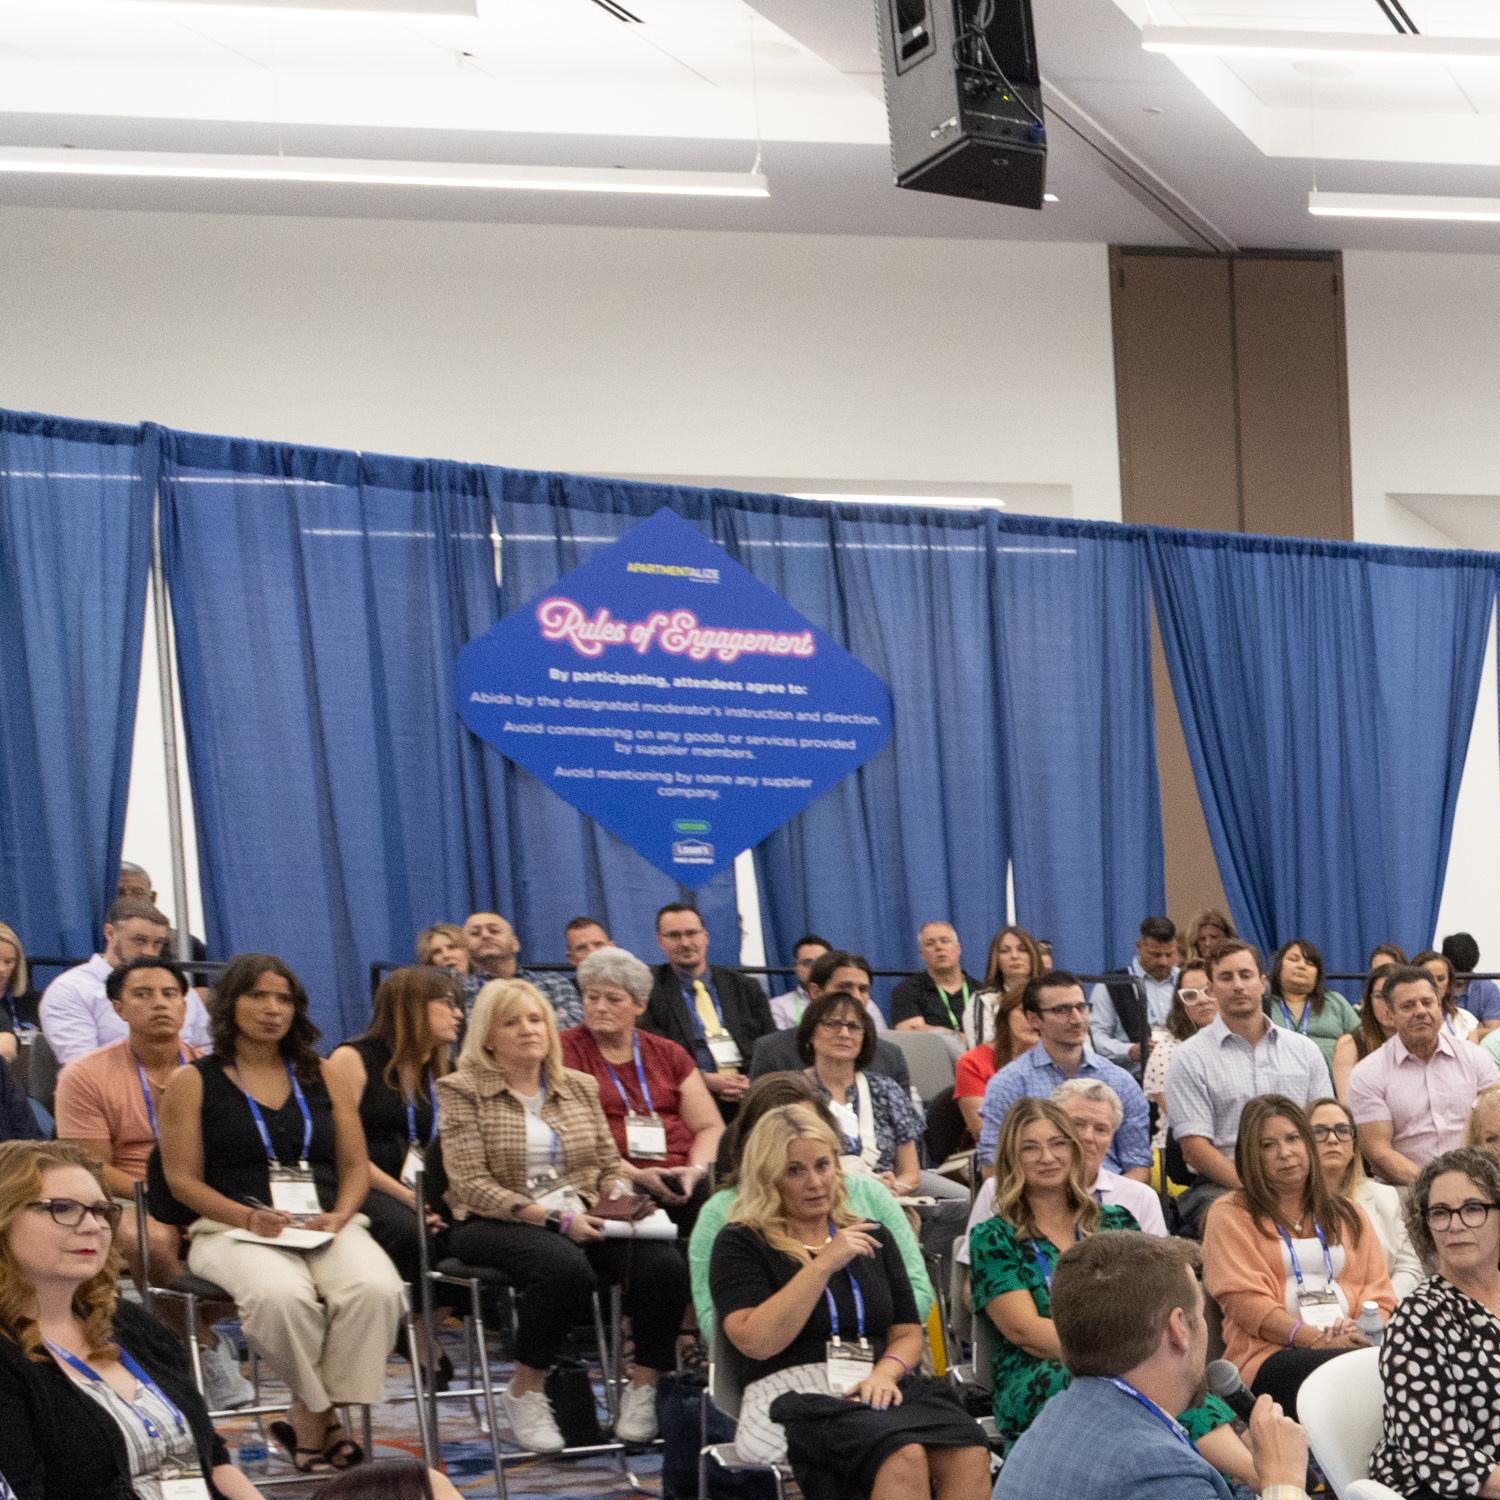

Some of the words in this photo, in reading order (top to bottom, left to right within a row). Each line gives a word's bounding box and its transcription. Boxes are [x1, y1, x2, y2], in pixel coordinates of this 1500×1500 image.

[538, 598, 629, 656] Rules
[629, 612, 670, 654] of
[660, 609, 815, 662] Engagement
[548, 667, 570, 682] By
[572, 670, 671, 688] participating,
[672, 677, 743, 691] attendees
[745, 682, 786, 694] agree
[470, 691, 513, 705] Abide
[515, 694, 533, 707] by
[537, 695, 561, 707] the
[563, 696, 640, 712] designated
[724, 706, 794, 720] instruction
[795, 711, 821, 722] and
[503, 721, 545, 734] Avoid
[546, 725, 634, 740] commenting
[635, 729, 655, 739] on
[655, 731, 682, 743] any
[683, 731, 726, 744] goods
[728, 733, 743, 744] or
[745, 735, 799, 747] services
[799, 738, 857, 750] provided
[613, 742, 634, 754] by
[635, 744, 689, 756] supplier
[554, 766, 595, 778] Avoid
[596, 768, 674, 784] mentioning
[675, 771, 694, 784] by
[695, 773, 733, 785] name
[735, 775, 760, 787] any
[760, 776, 814, 788] supplier
